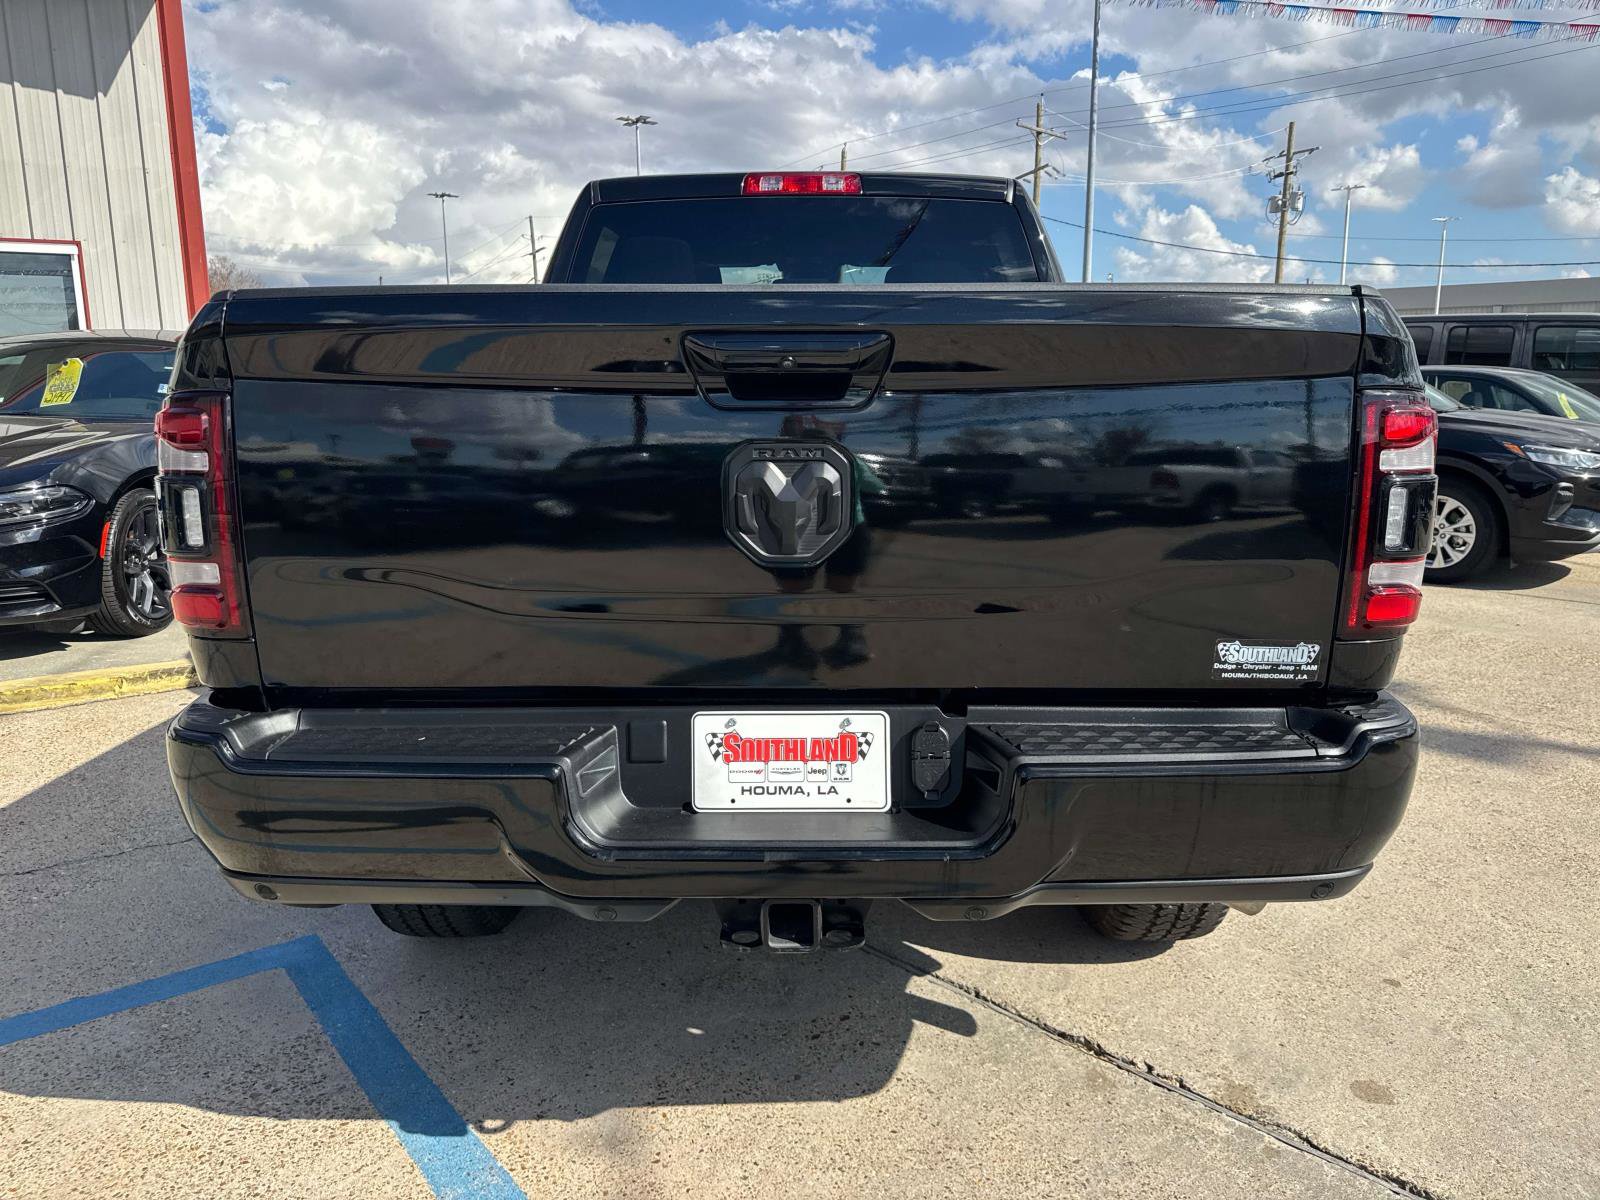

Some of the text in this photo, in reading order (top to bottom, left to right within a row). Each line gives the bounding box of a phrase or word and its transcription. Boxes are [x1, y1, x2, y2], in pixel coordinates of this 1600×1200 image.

[752, 447, 824, 458] RAM
[1229, 644, 1309, 663] SOUTHLAND
[1242, 663, 1271, 671] Chrysler
[722, 731, 859, 765] SOUTHLAND
[807, 767, 827, 776] Jeep
[741, 786, 839, 797] HOUMA, LA
